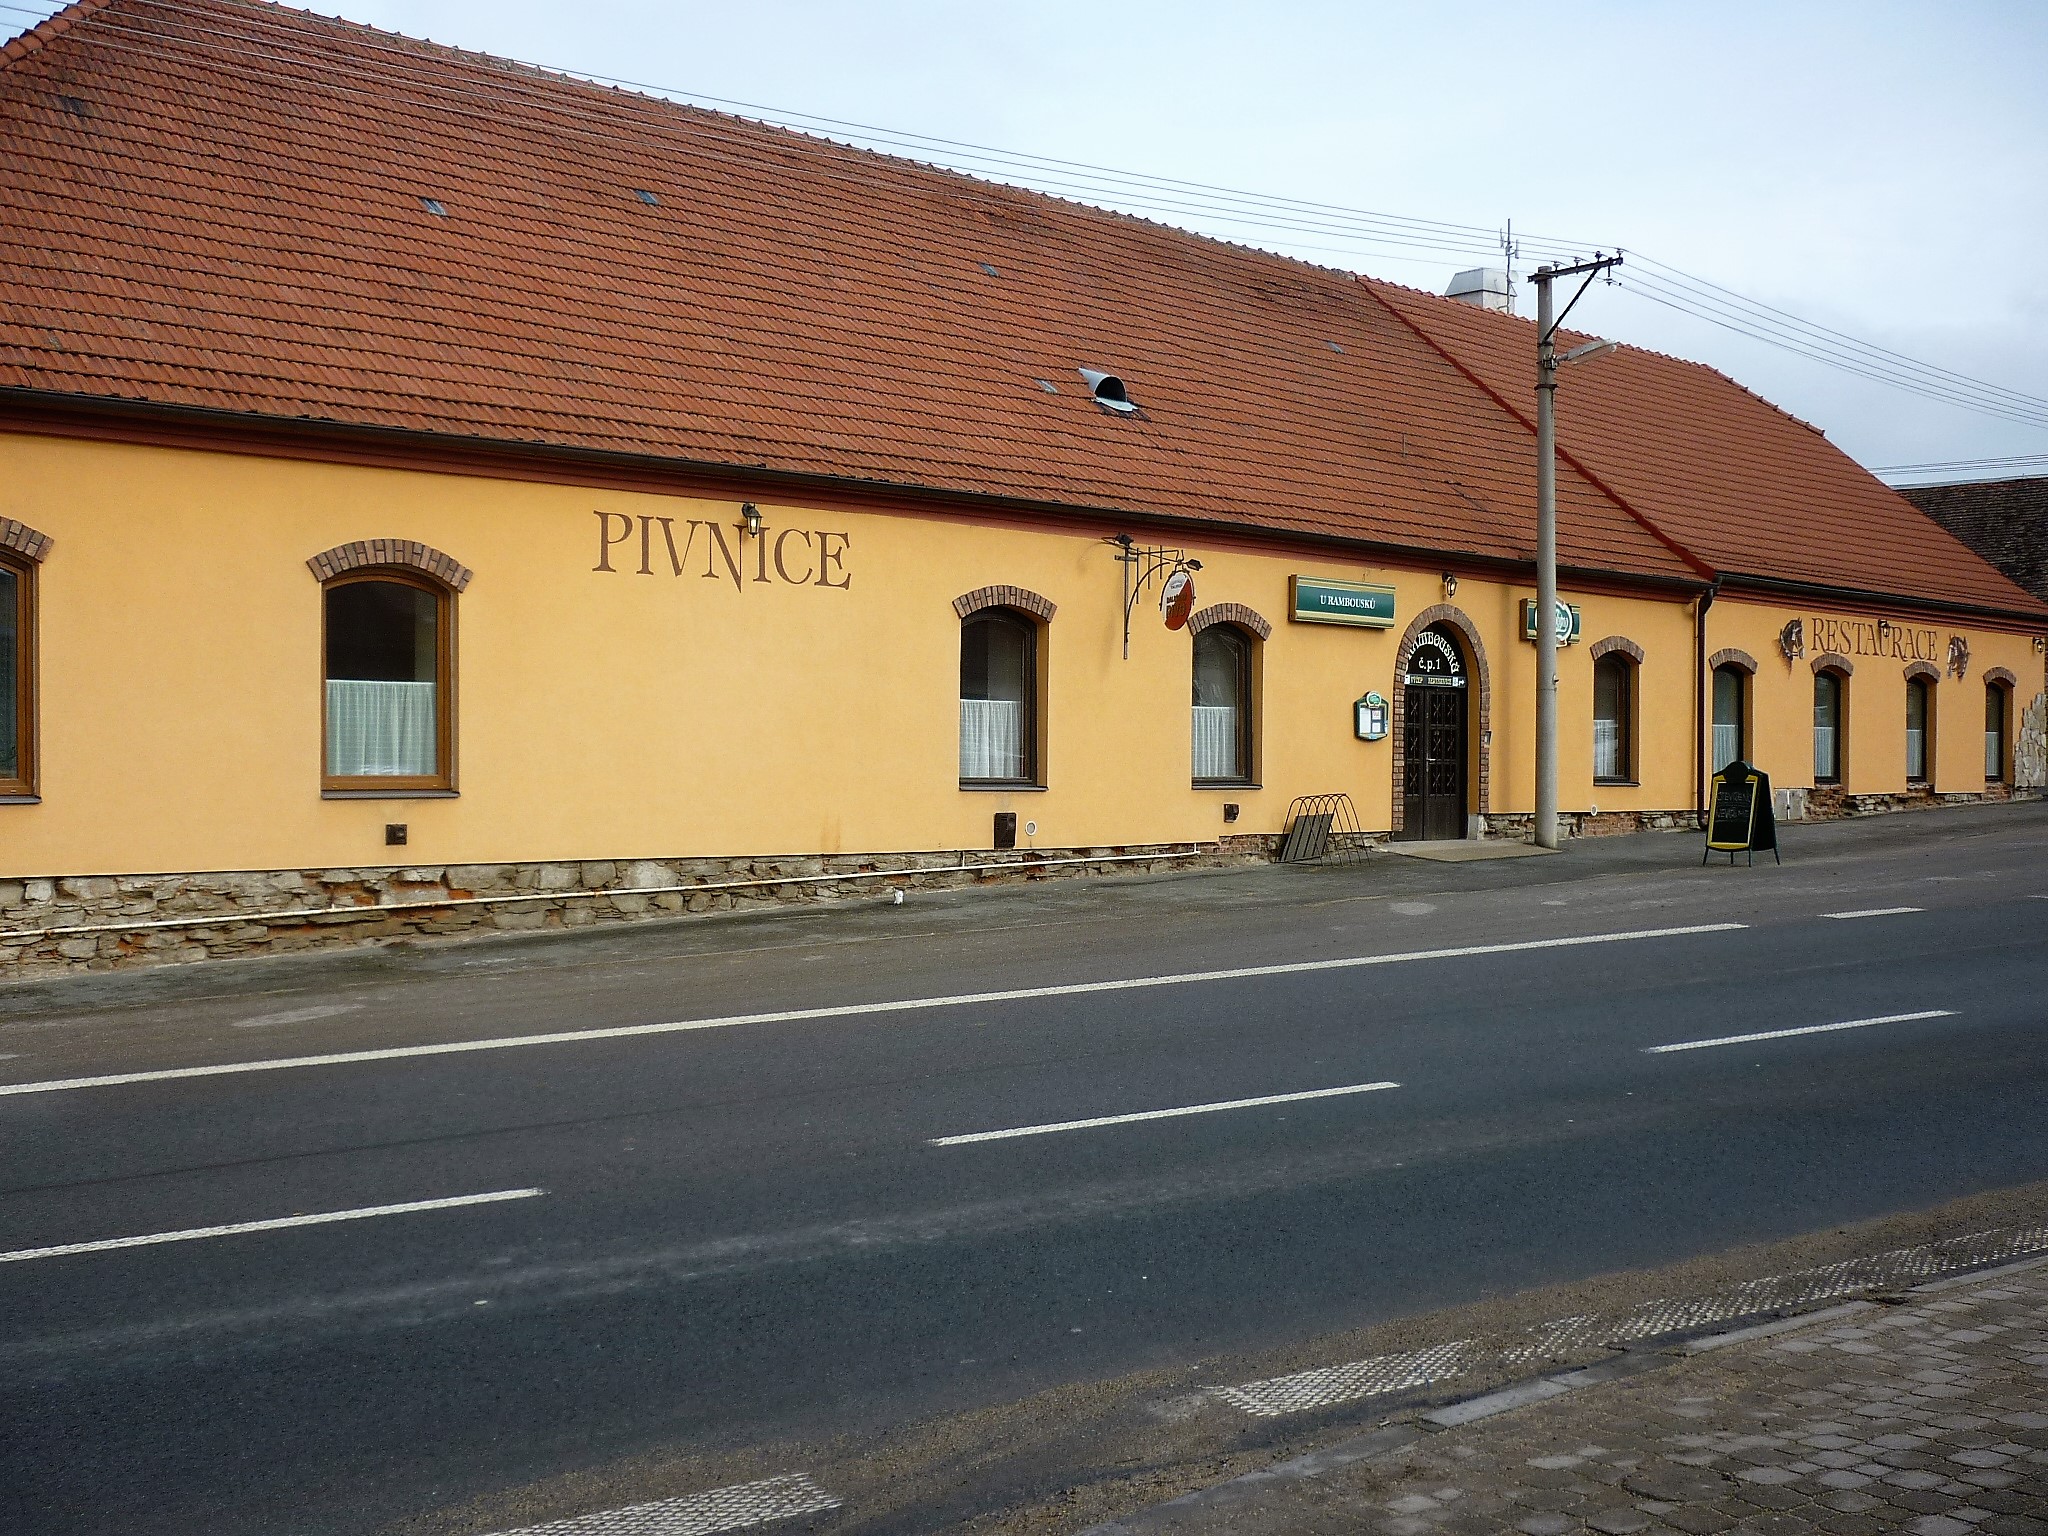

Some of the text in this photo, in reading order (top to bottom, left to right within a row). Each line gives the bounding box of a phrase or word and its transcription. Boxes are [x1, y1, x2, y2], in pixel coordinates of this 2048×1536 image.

[592, 510, 851, 593] PIVNICE
[1320, 595, 1376, 609] U RAMBOUSKŮ
[1811, 617, 1938, 662] RESTAURACE
